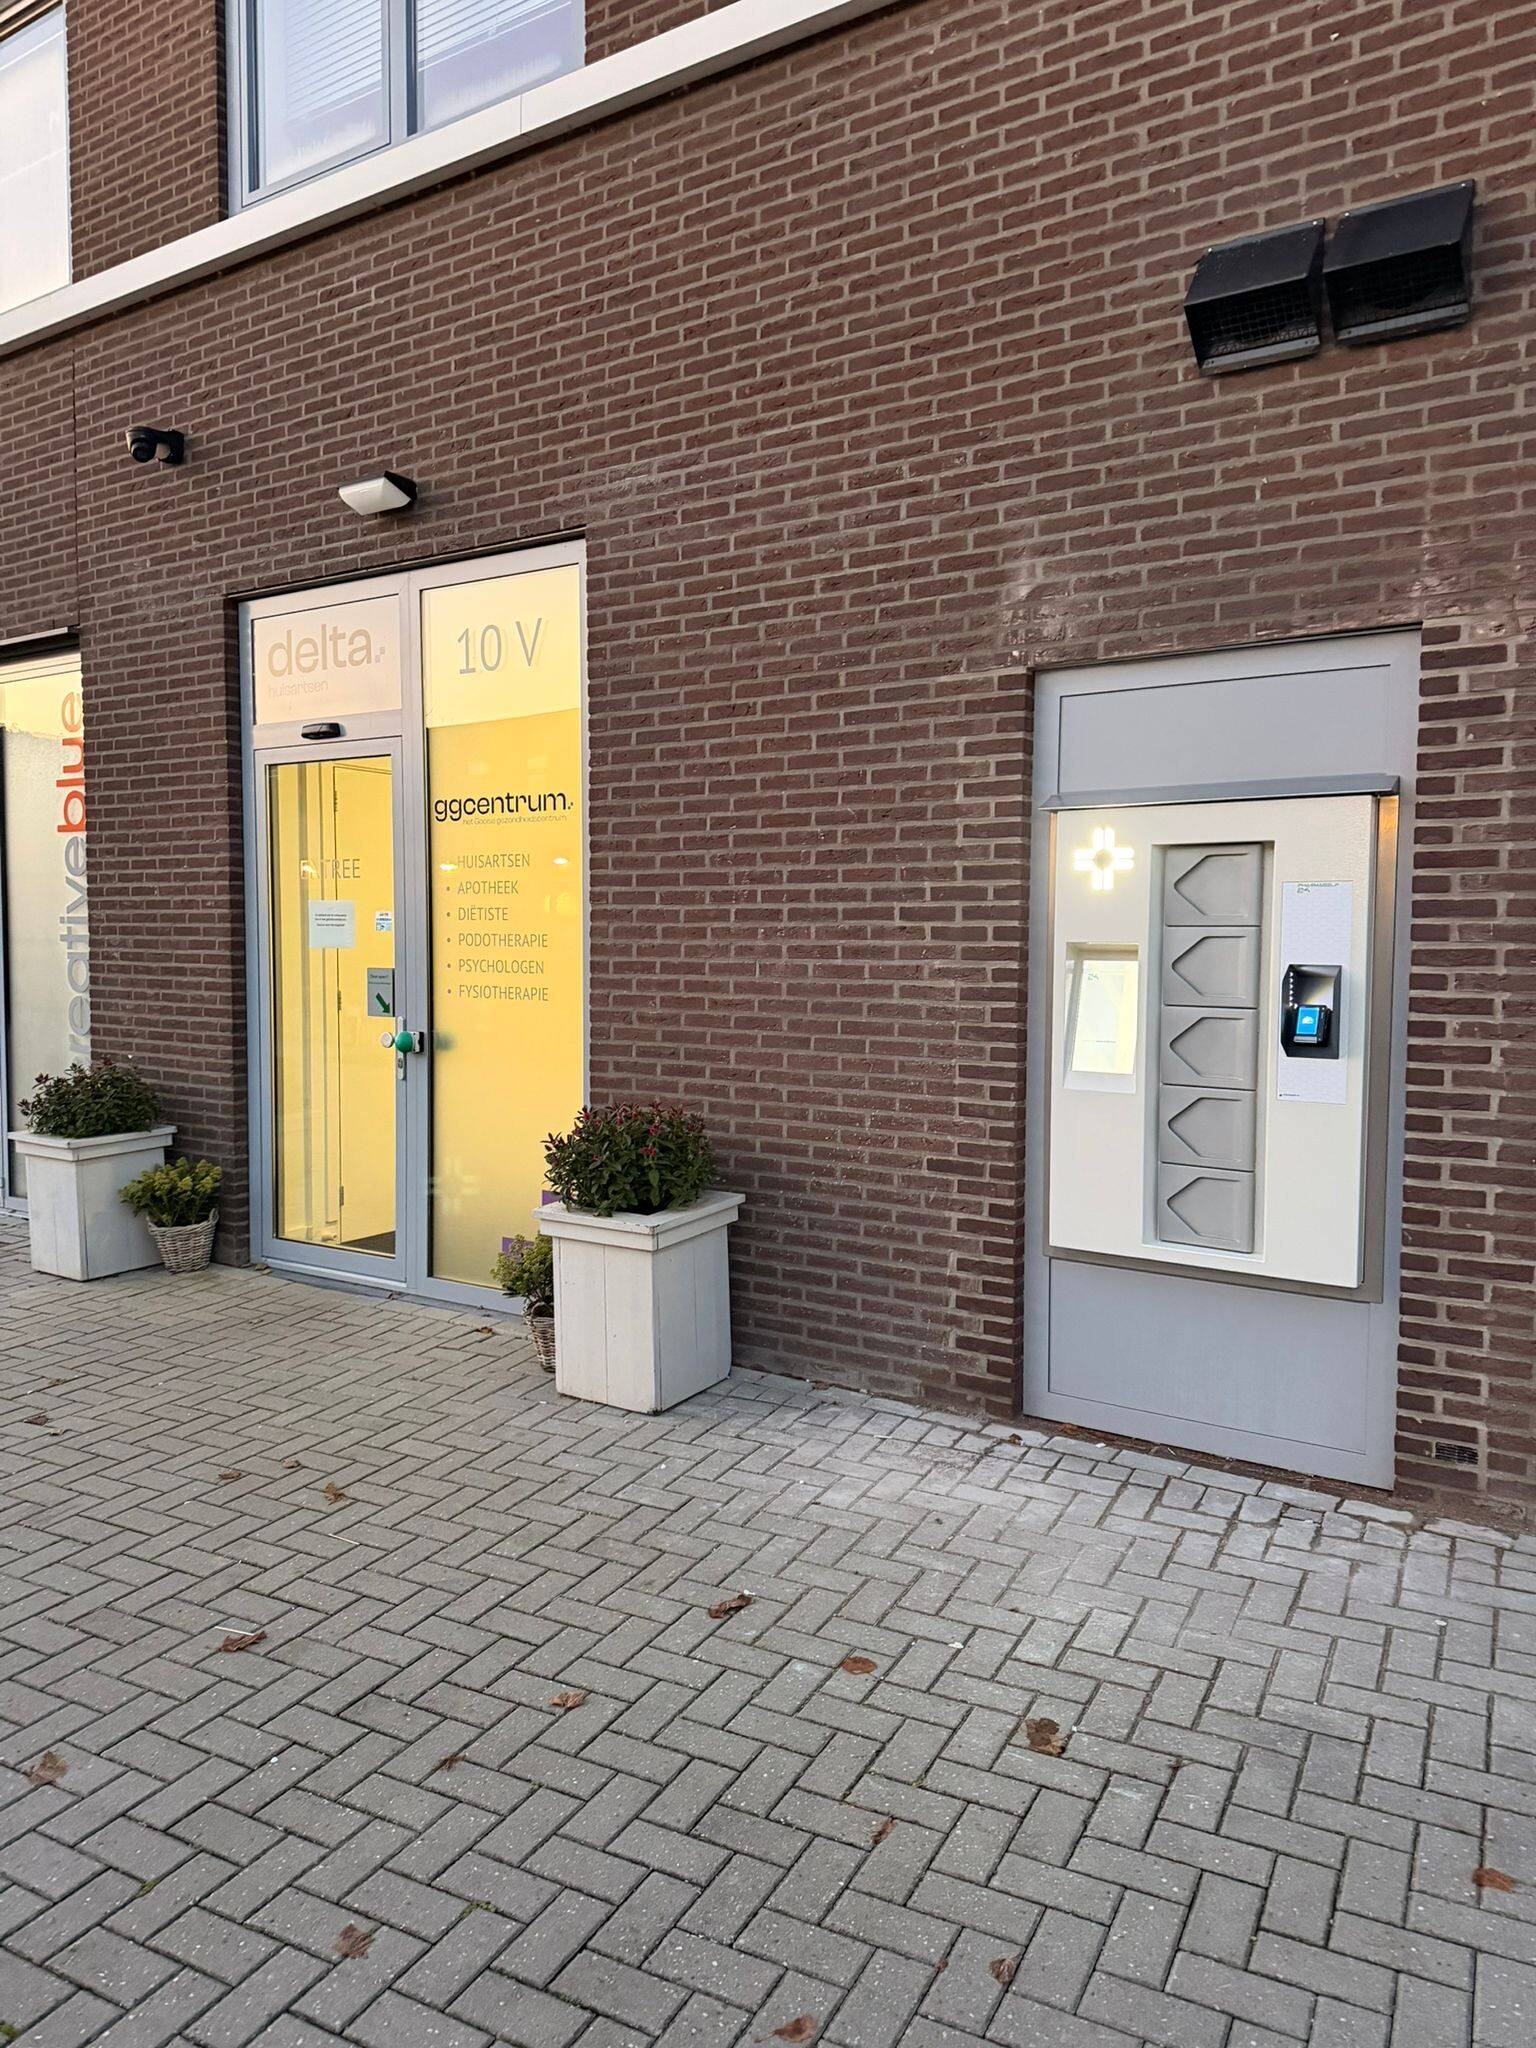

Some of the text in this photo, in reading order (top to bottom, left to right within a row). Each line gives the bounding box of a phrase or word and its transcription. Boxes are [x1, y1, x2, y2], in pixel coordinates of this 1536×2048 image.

[456, 617, 544, 675] 10 V
[457, 853, 530, 869] HUISARTSEN
[457, 880, 519, 895] APOTHEEK
[458, 904, 509, 921] DIËTISTE
[458, 933, 548, 948] PODOTHERAPIE
[458, 958, 544, 975] PSYCHOLOGEN
[458, 985, 549, 1002] FYSIOTHERAPIE
